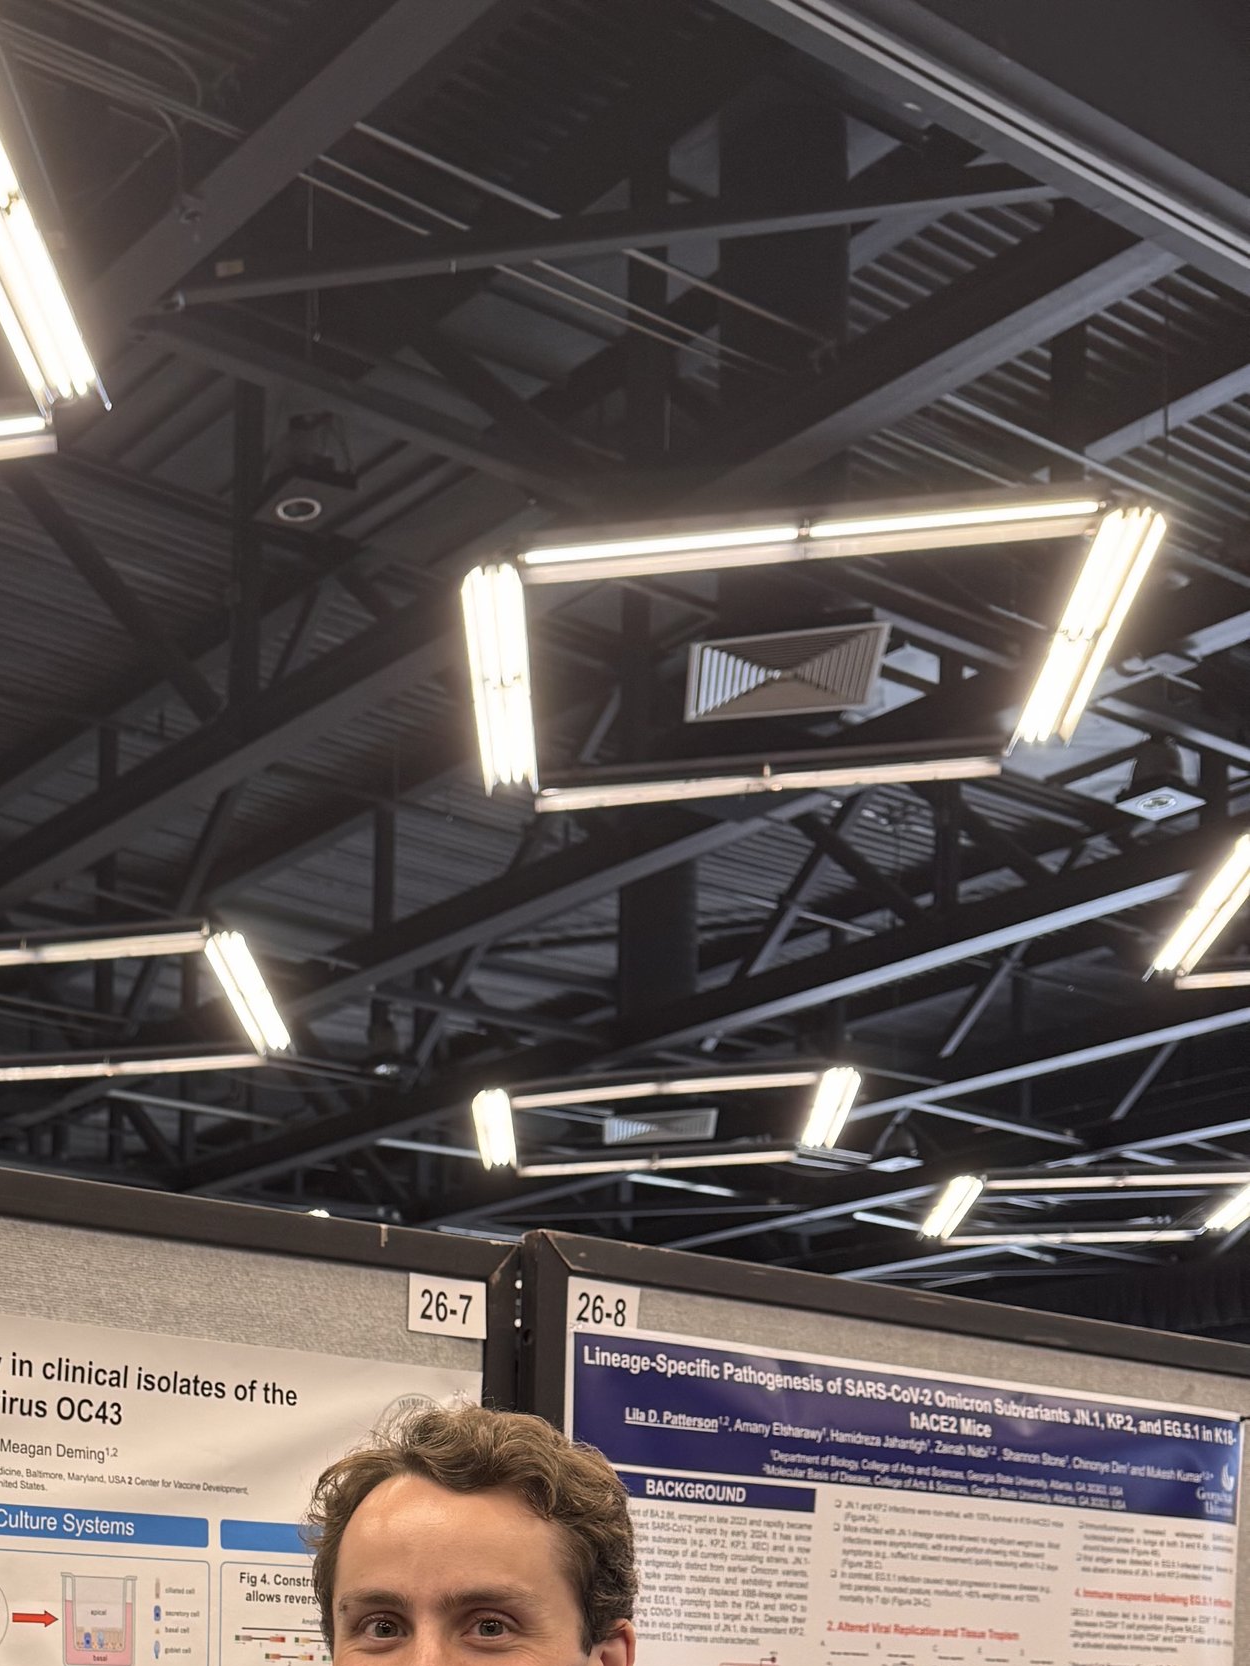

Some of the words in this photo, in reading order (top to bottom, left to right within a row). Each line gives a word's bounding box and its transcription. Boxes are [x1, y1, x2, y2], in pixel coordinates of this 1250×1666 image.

[420, 1289, 473, 1325] 26-7
[576, 1292, 627, 1327] 26-8
[11, 1351, 32, 1378] in
[42, 1357, 128, 1388] clinical
[136, 1366, 226, 1399] isolates
[234, 1379, 257, 1402] of
[262, 1381, 297, 1406] the
[583, 1345, 720, 1379] Lineage-Specific
[722, 1361, 823, 1392] Pathogenesis
[826, 1376, 842, 1394] of
[844, 1378, 932, 1405] SARS-CoV-2
[934, 1389, 992, 1413] Omicron
[993, 1397, 1070, 1423] Subvariants
[1138, 1418, 1162, 1435] and
[1162, 1419, 1199, 1440] EG.5.1
[1201, 1424, 1212, 1442] in
[56, 1396, 122, 1425] OC43
[909, 1411, 957, 1433] hACE2
[959, 1417, 992, 1438] Mice
[0, 1438, 52, 1457] Meagan
[646, 1479, 746, 1503] BACKGROUND
[62, 1512, 134, 1537] Systems
[239, 1572, 257, 1587] Fig
[260, 1573, 270, 1585] 4.
[246, 1590, 281, 1603] allows
